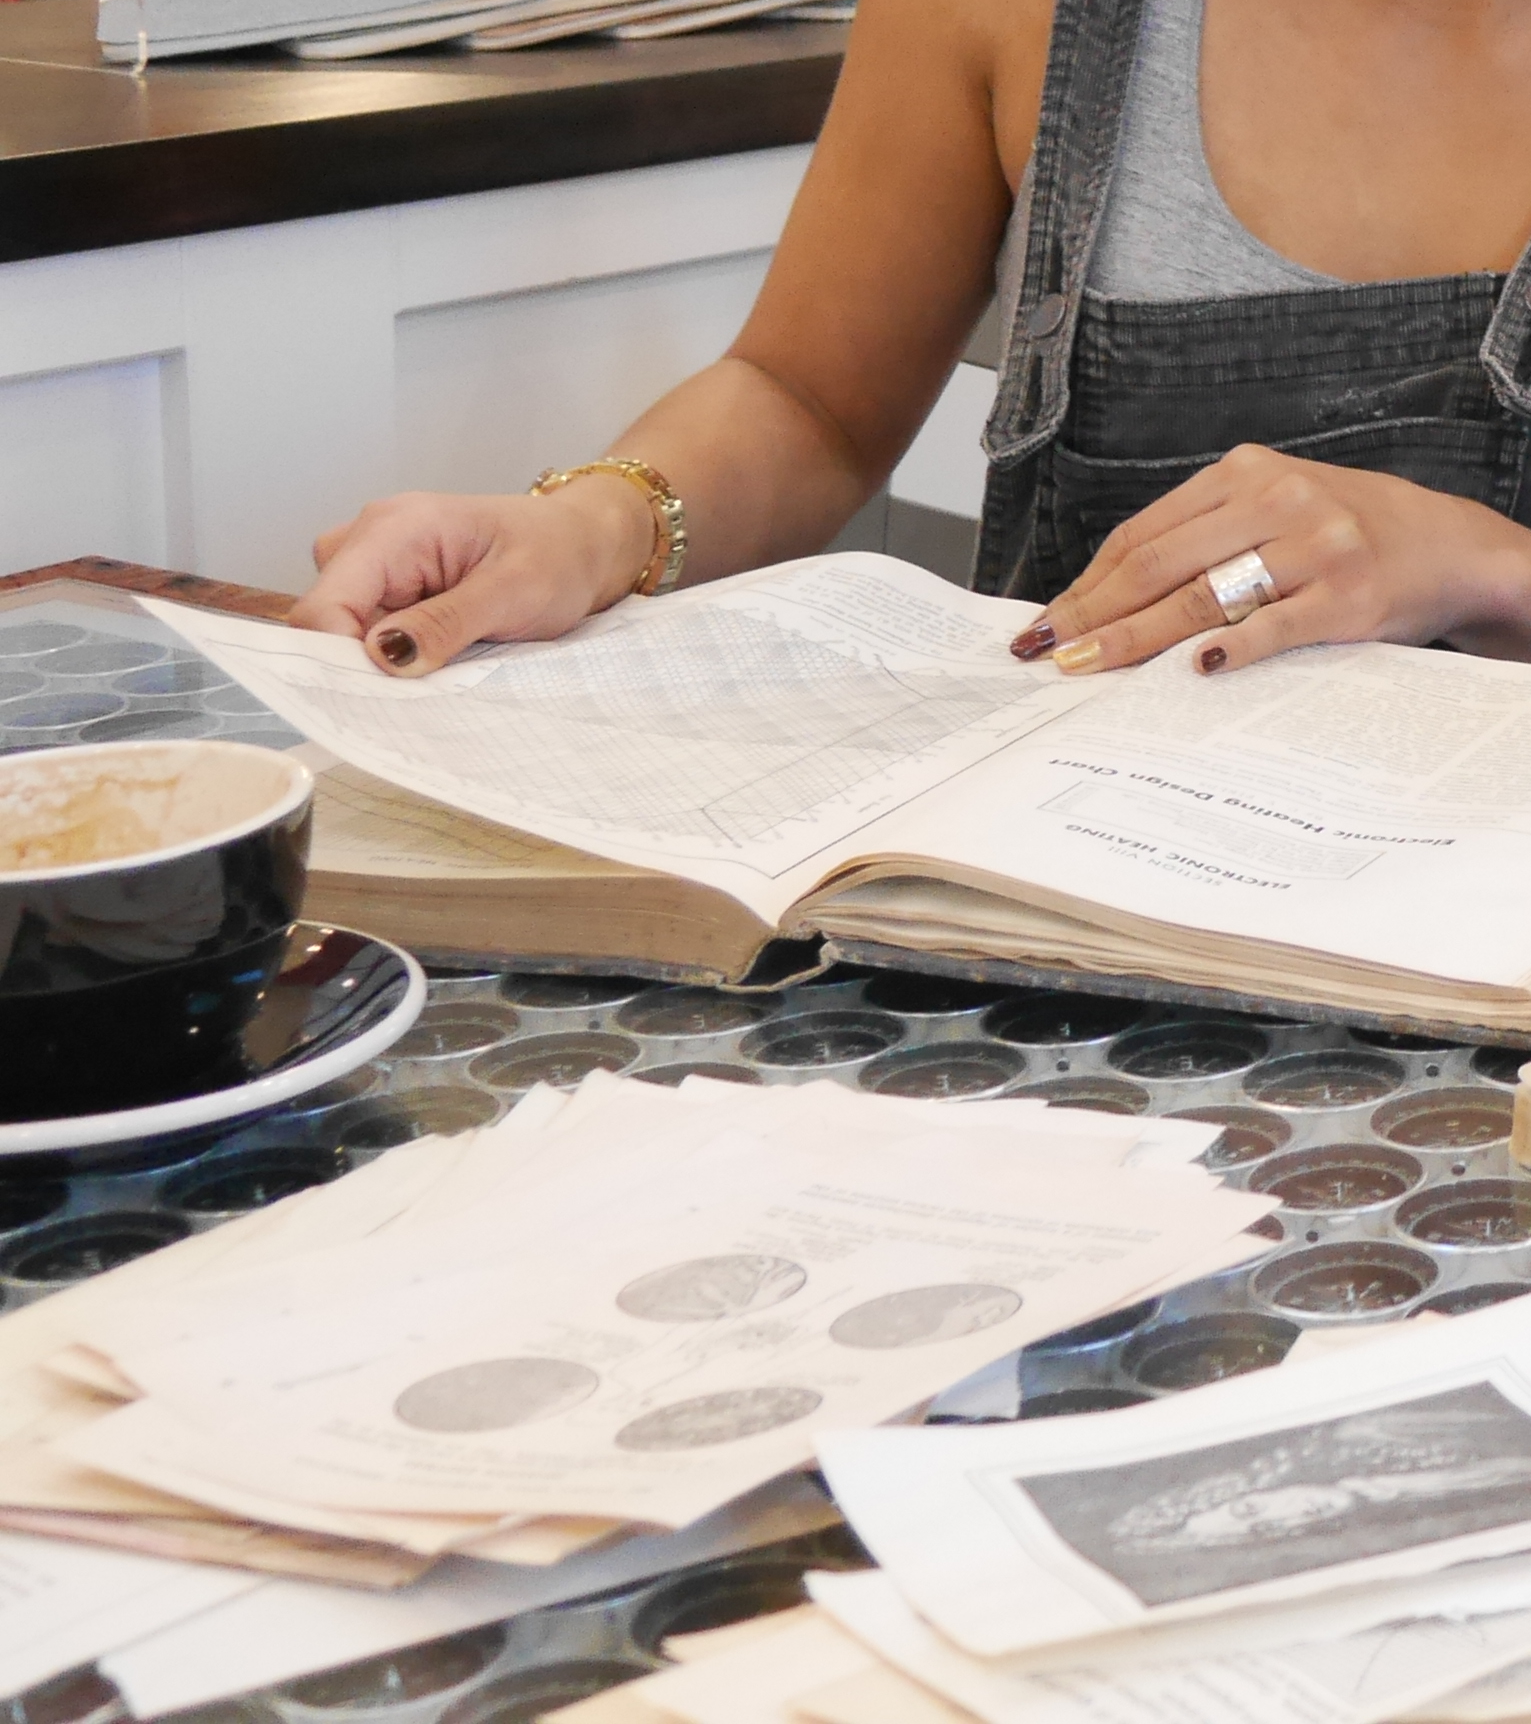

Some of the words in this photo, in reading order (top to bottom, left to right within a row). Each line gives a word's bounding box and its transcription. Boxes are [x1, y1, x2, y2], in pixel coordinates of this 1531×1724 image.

[1049, 758, 1118, 776] Chart
[1129, 772, 1214, 802] Design
[1223, 797, 1325, 834] Heating
[1065, 823, 1158, 854] HEATING
[1333, 829, 1456, 847] Electronic
[1148, 859, 1223, 887] SECTION
[1165, 851, 1292, 890] ELECTRONIC
